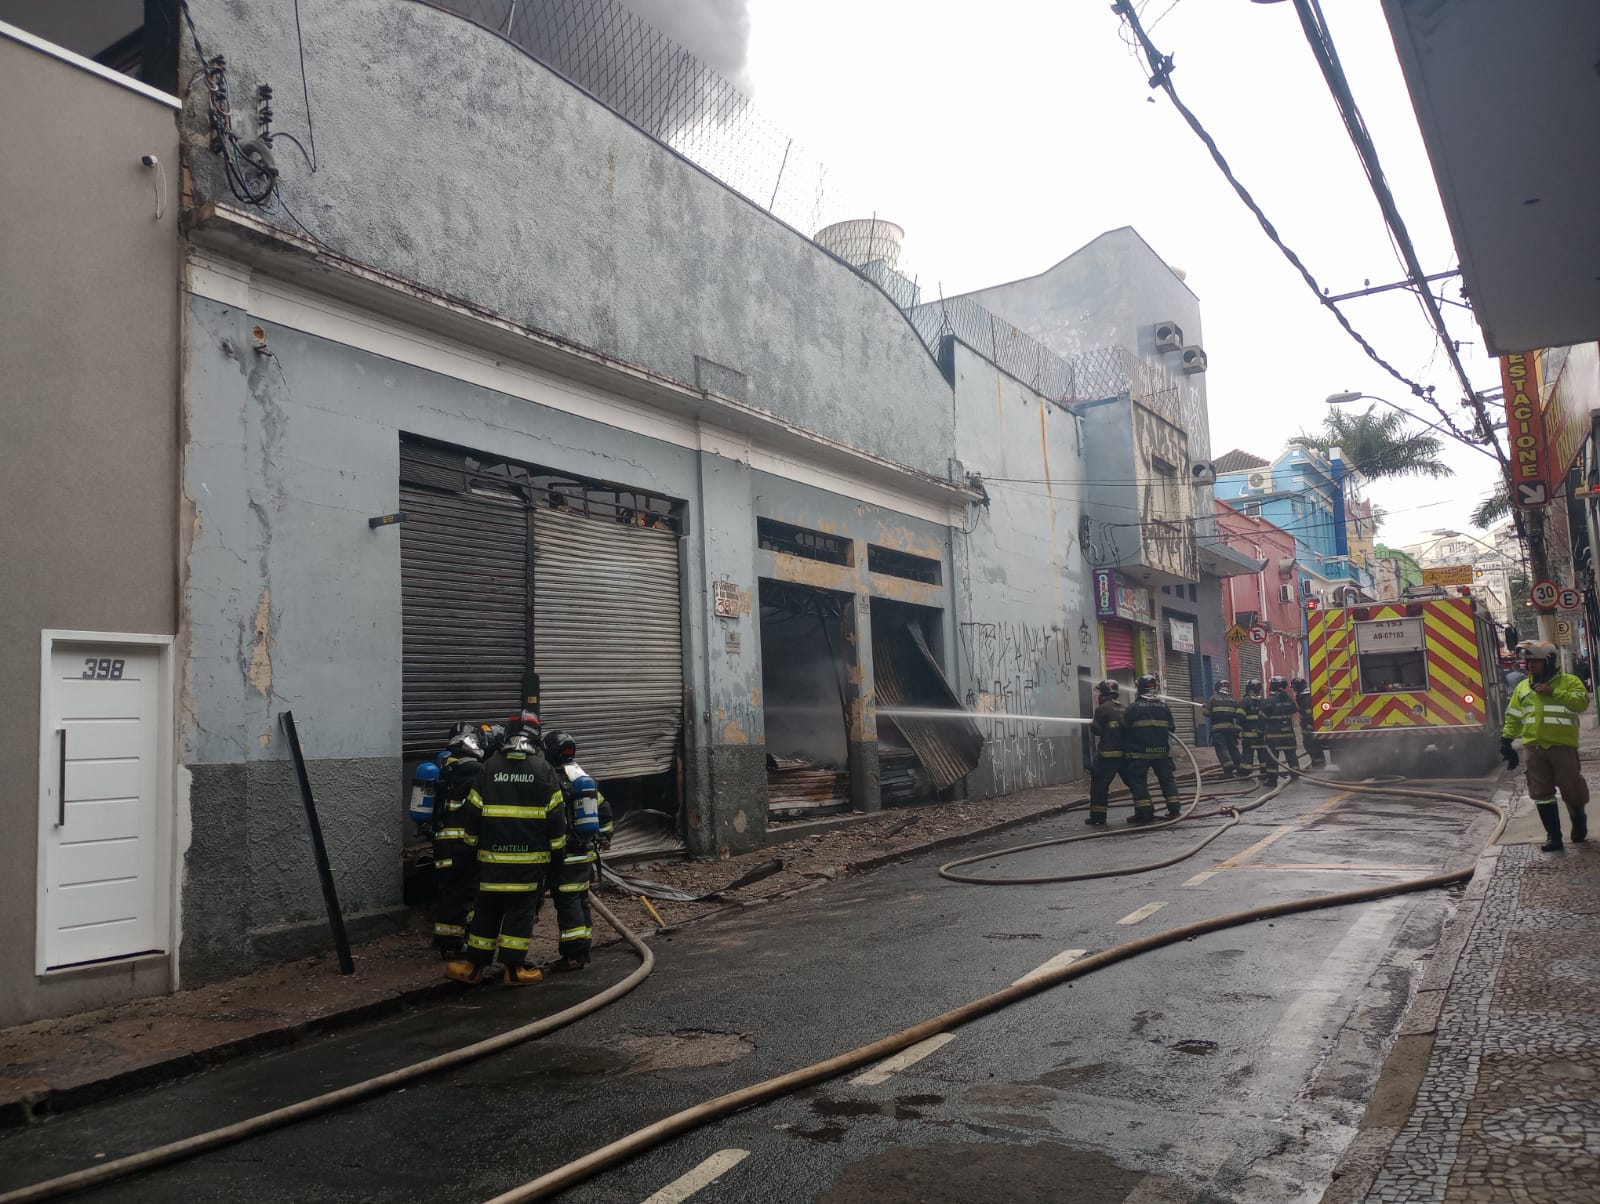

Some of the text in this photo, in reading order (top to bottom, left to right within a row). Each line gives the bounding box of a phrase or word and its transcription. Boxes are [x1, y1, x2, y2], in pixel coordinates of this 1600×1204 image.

[1536, 585, 1554, 600] 30
[1563, 593, 1573, 606] E
[82, 658, 125, 680] 398
[493, 771, 535, 783] SÃO PAULO
[491, 844, 529, 852] CANTELLI
